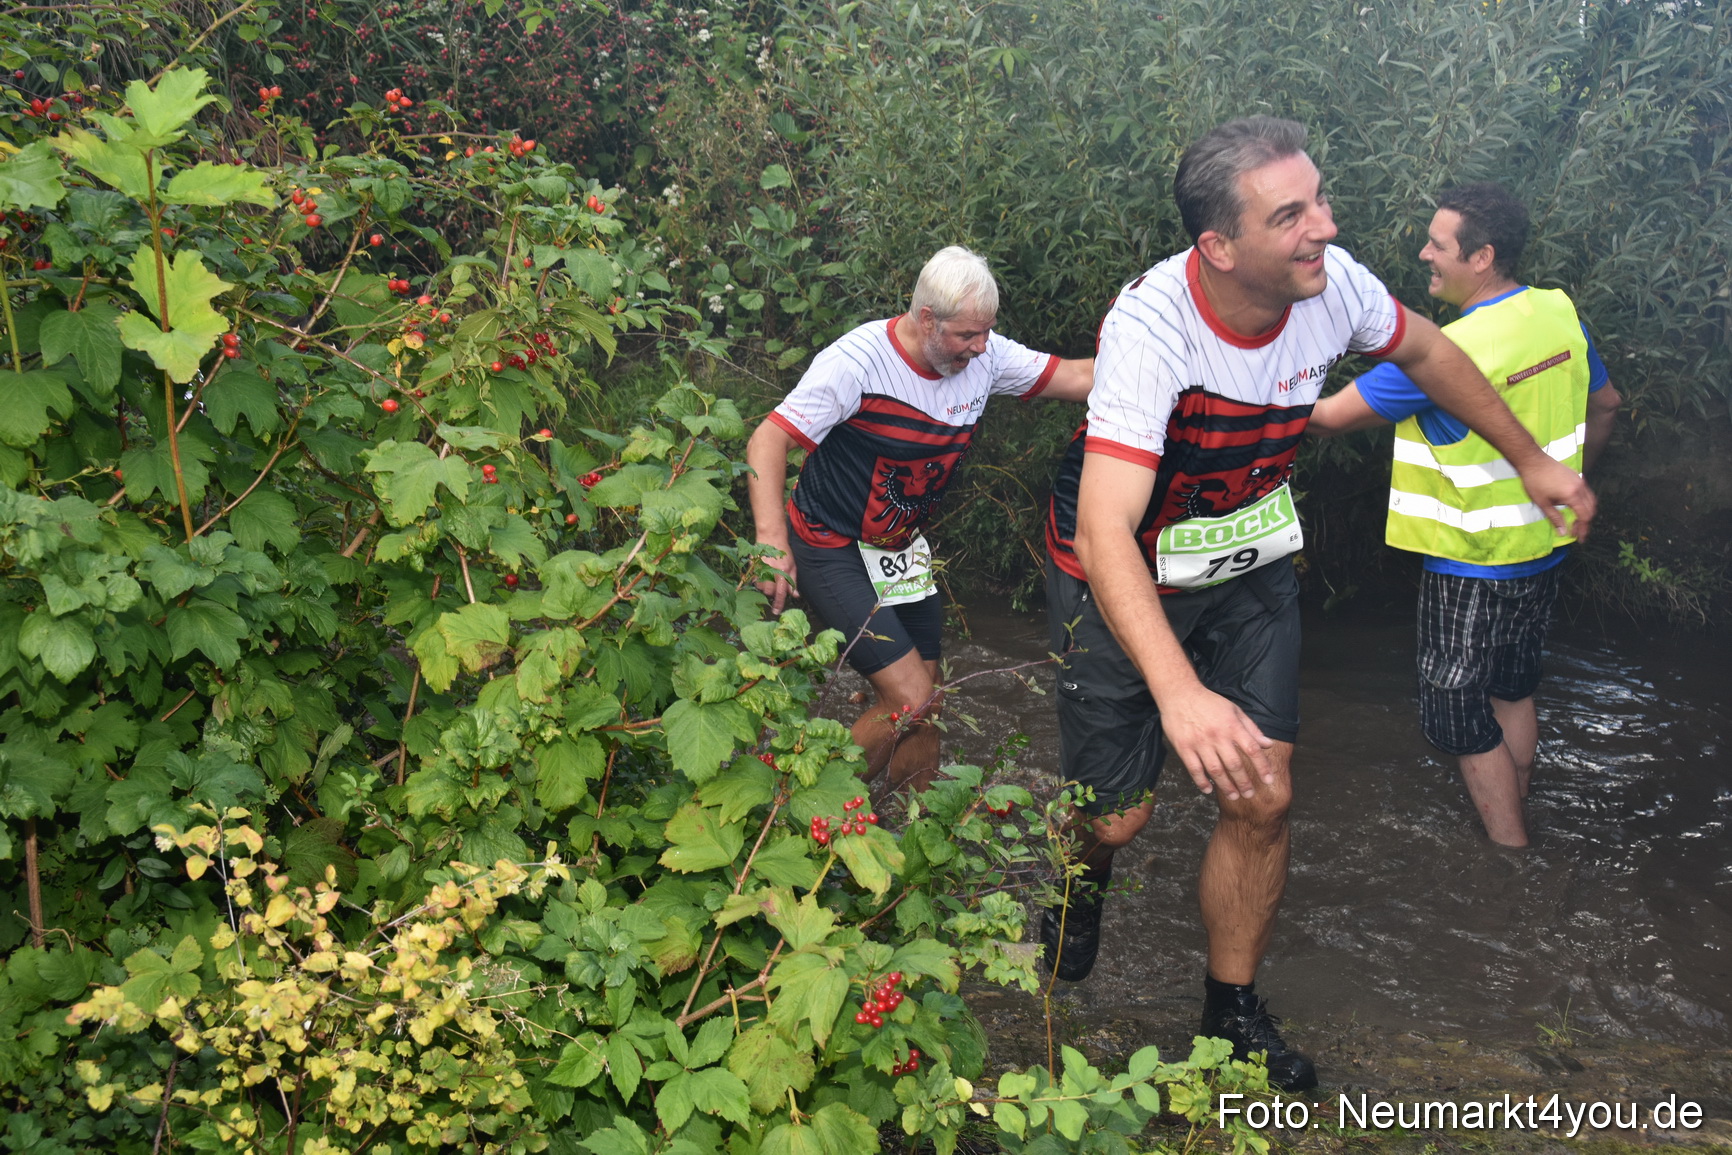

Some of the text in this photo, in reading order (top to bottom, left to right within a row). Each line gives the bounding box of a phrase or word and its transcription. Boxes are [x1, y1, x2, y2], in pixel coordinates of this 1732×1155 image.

[1170, 496, 1288, 552] BOCK
[879, 552, 908, 578] 80
[1205, 547, 1260, 580] 79
